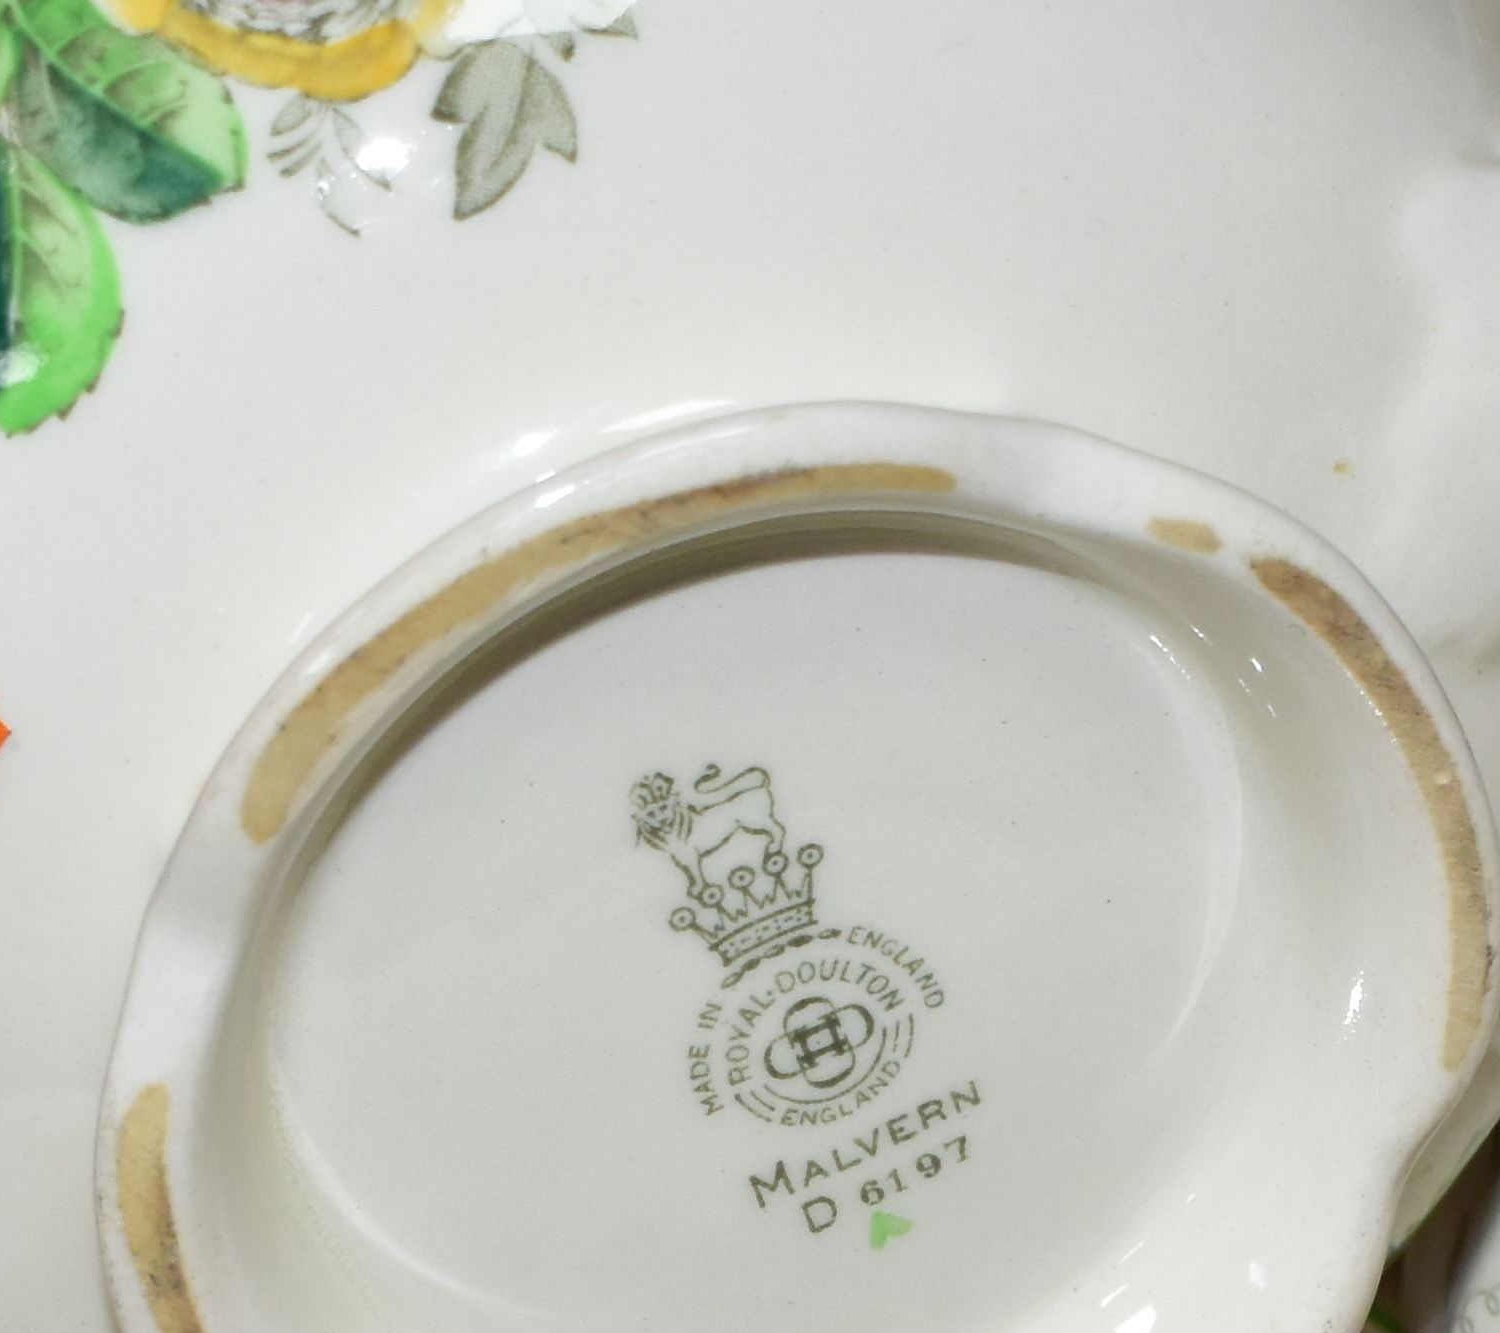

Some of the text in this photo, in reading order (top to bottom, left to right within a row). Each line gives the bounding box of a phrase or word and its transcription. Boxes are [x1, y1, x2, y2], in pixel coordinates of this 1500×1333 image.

[688, 925, 945, 1116] MADE IN ENGLAND
[748, 1079, 982, 1209] MALVERN
[779, 1060, 901, 1127] ENGLAND
[859, 1134, 971, 1206] 6197
